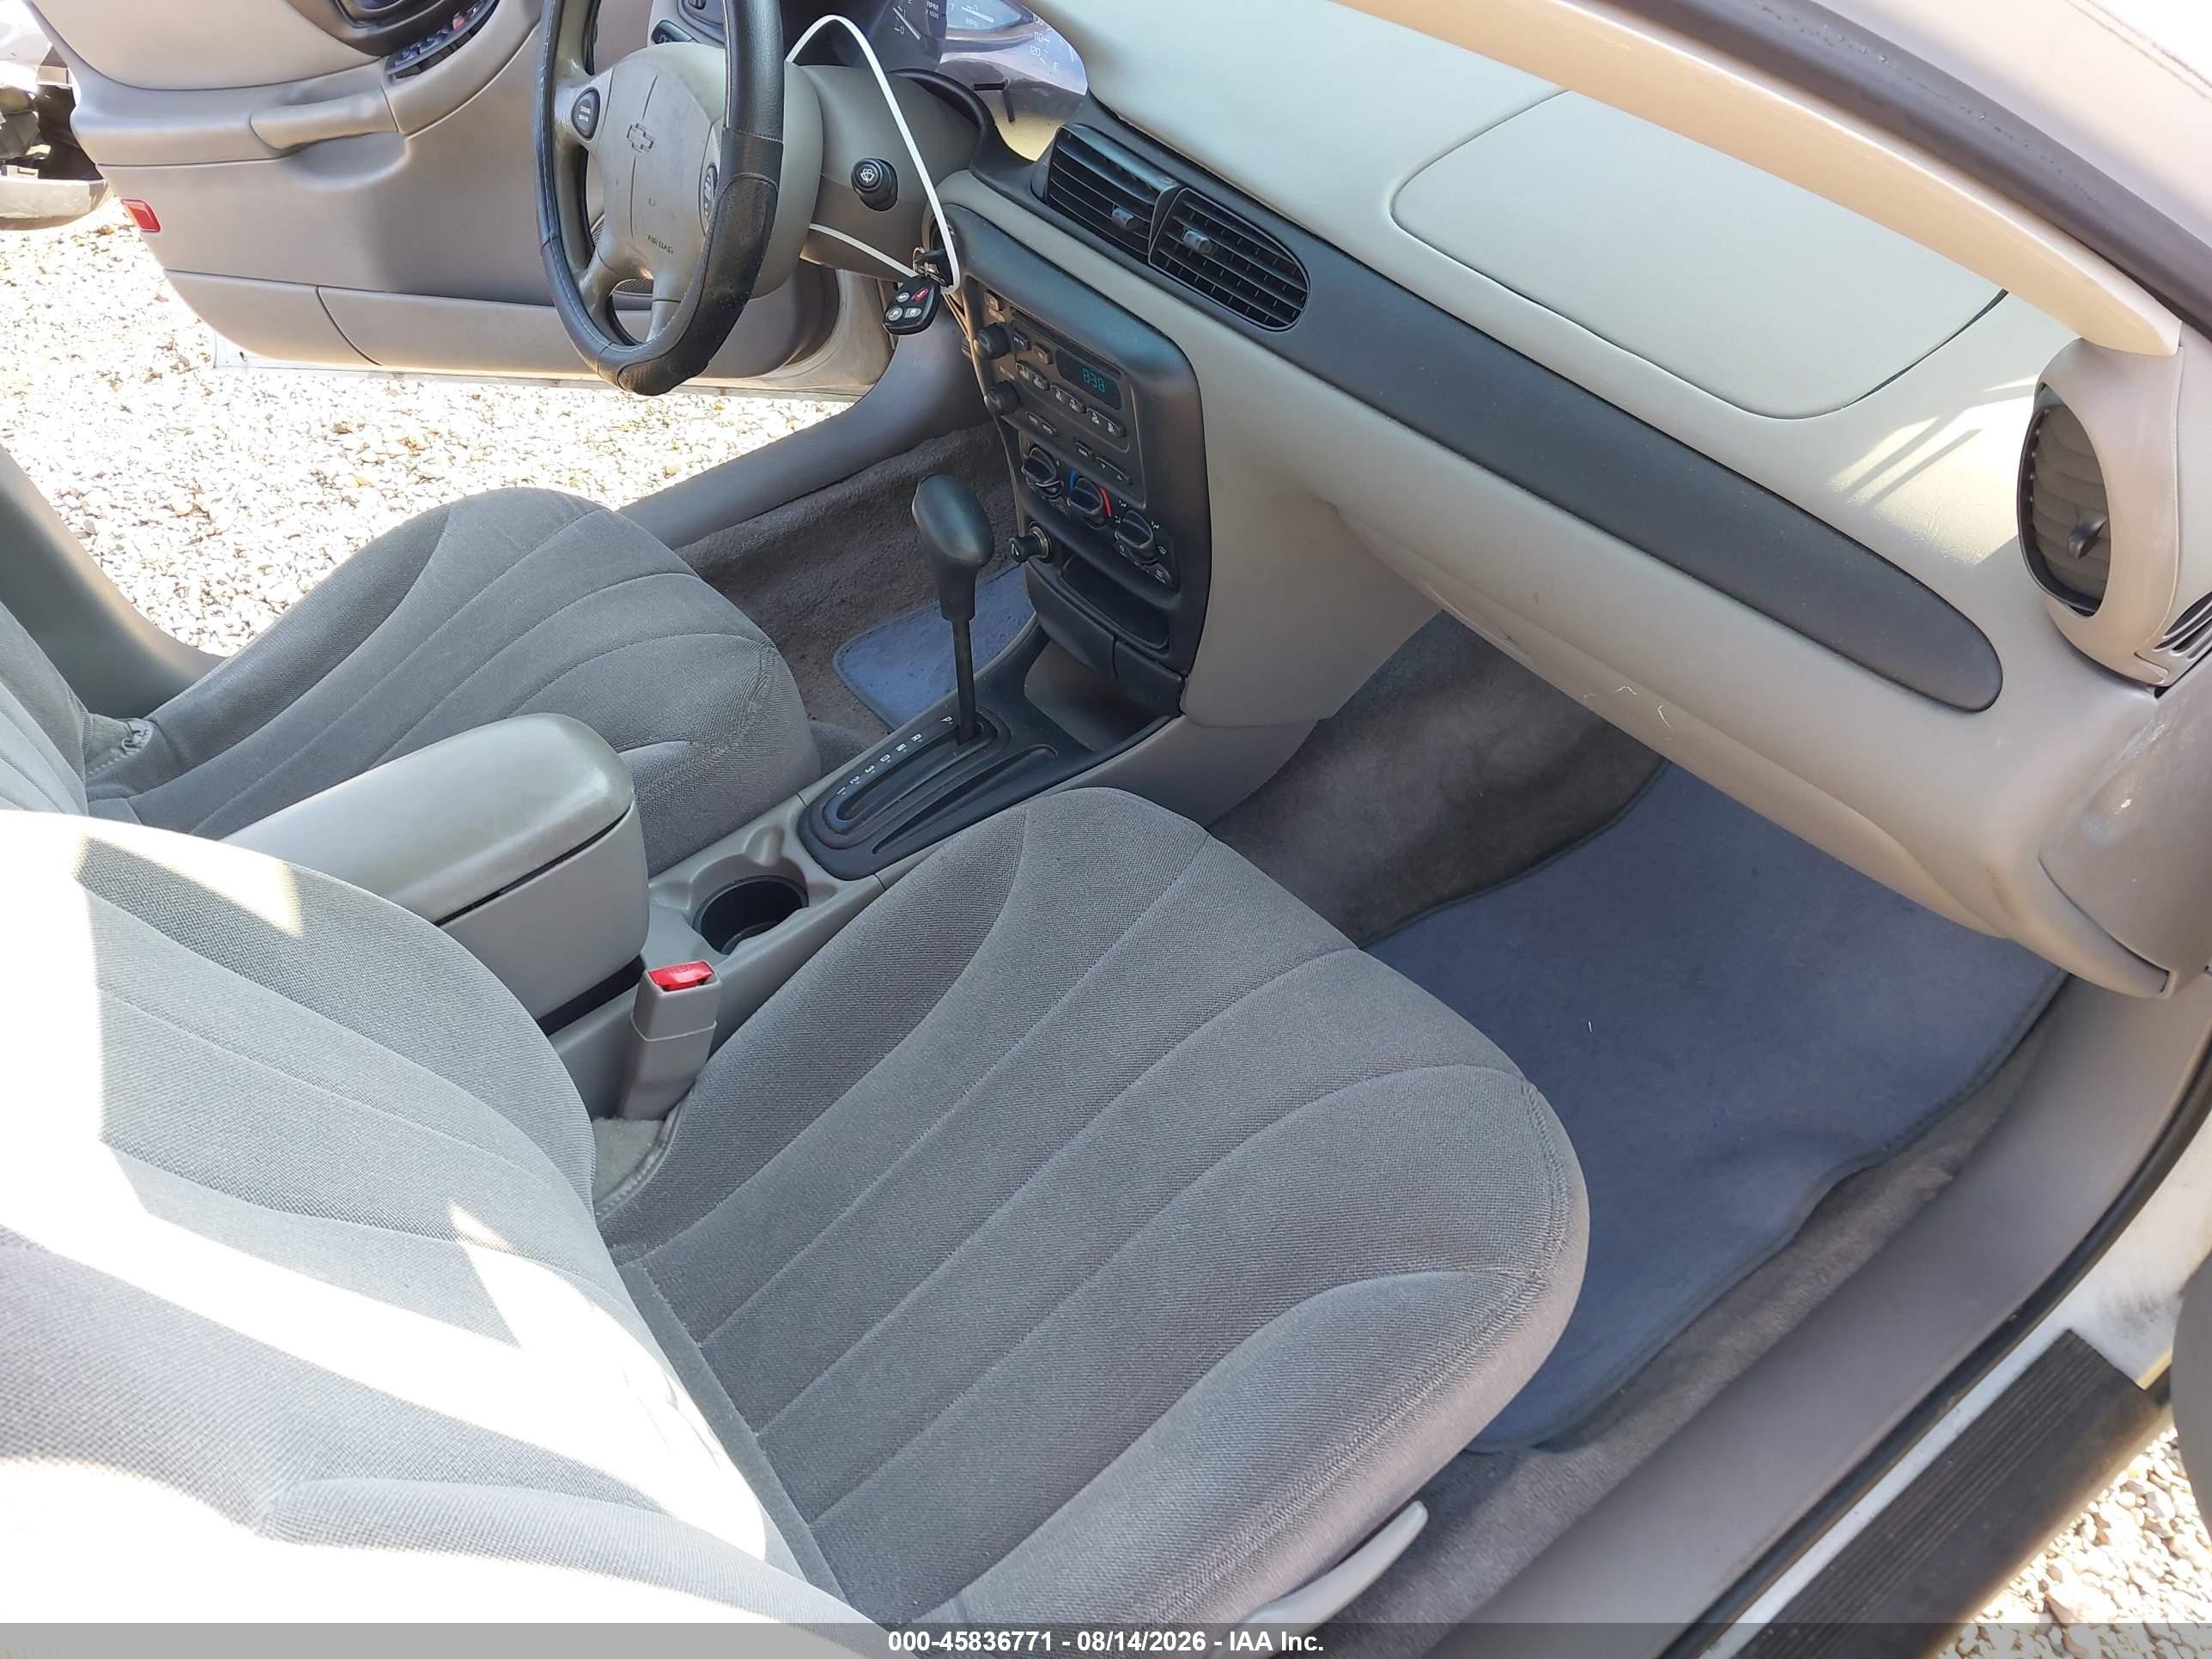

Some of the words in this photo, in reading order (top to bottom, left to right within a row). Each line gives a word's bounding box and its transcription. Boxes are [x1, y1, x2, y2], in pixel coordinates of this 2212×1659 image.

[965, 17, 979, 27] MPH
[1034, 31, 1044, 42] 110
[1030, 44, 1041, 57] 120
[910, 733, 922, 742] R
[865, 765, 875, 774] 3
[849, 775, 860, 785] 2
